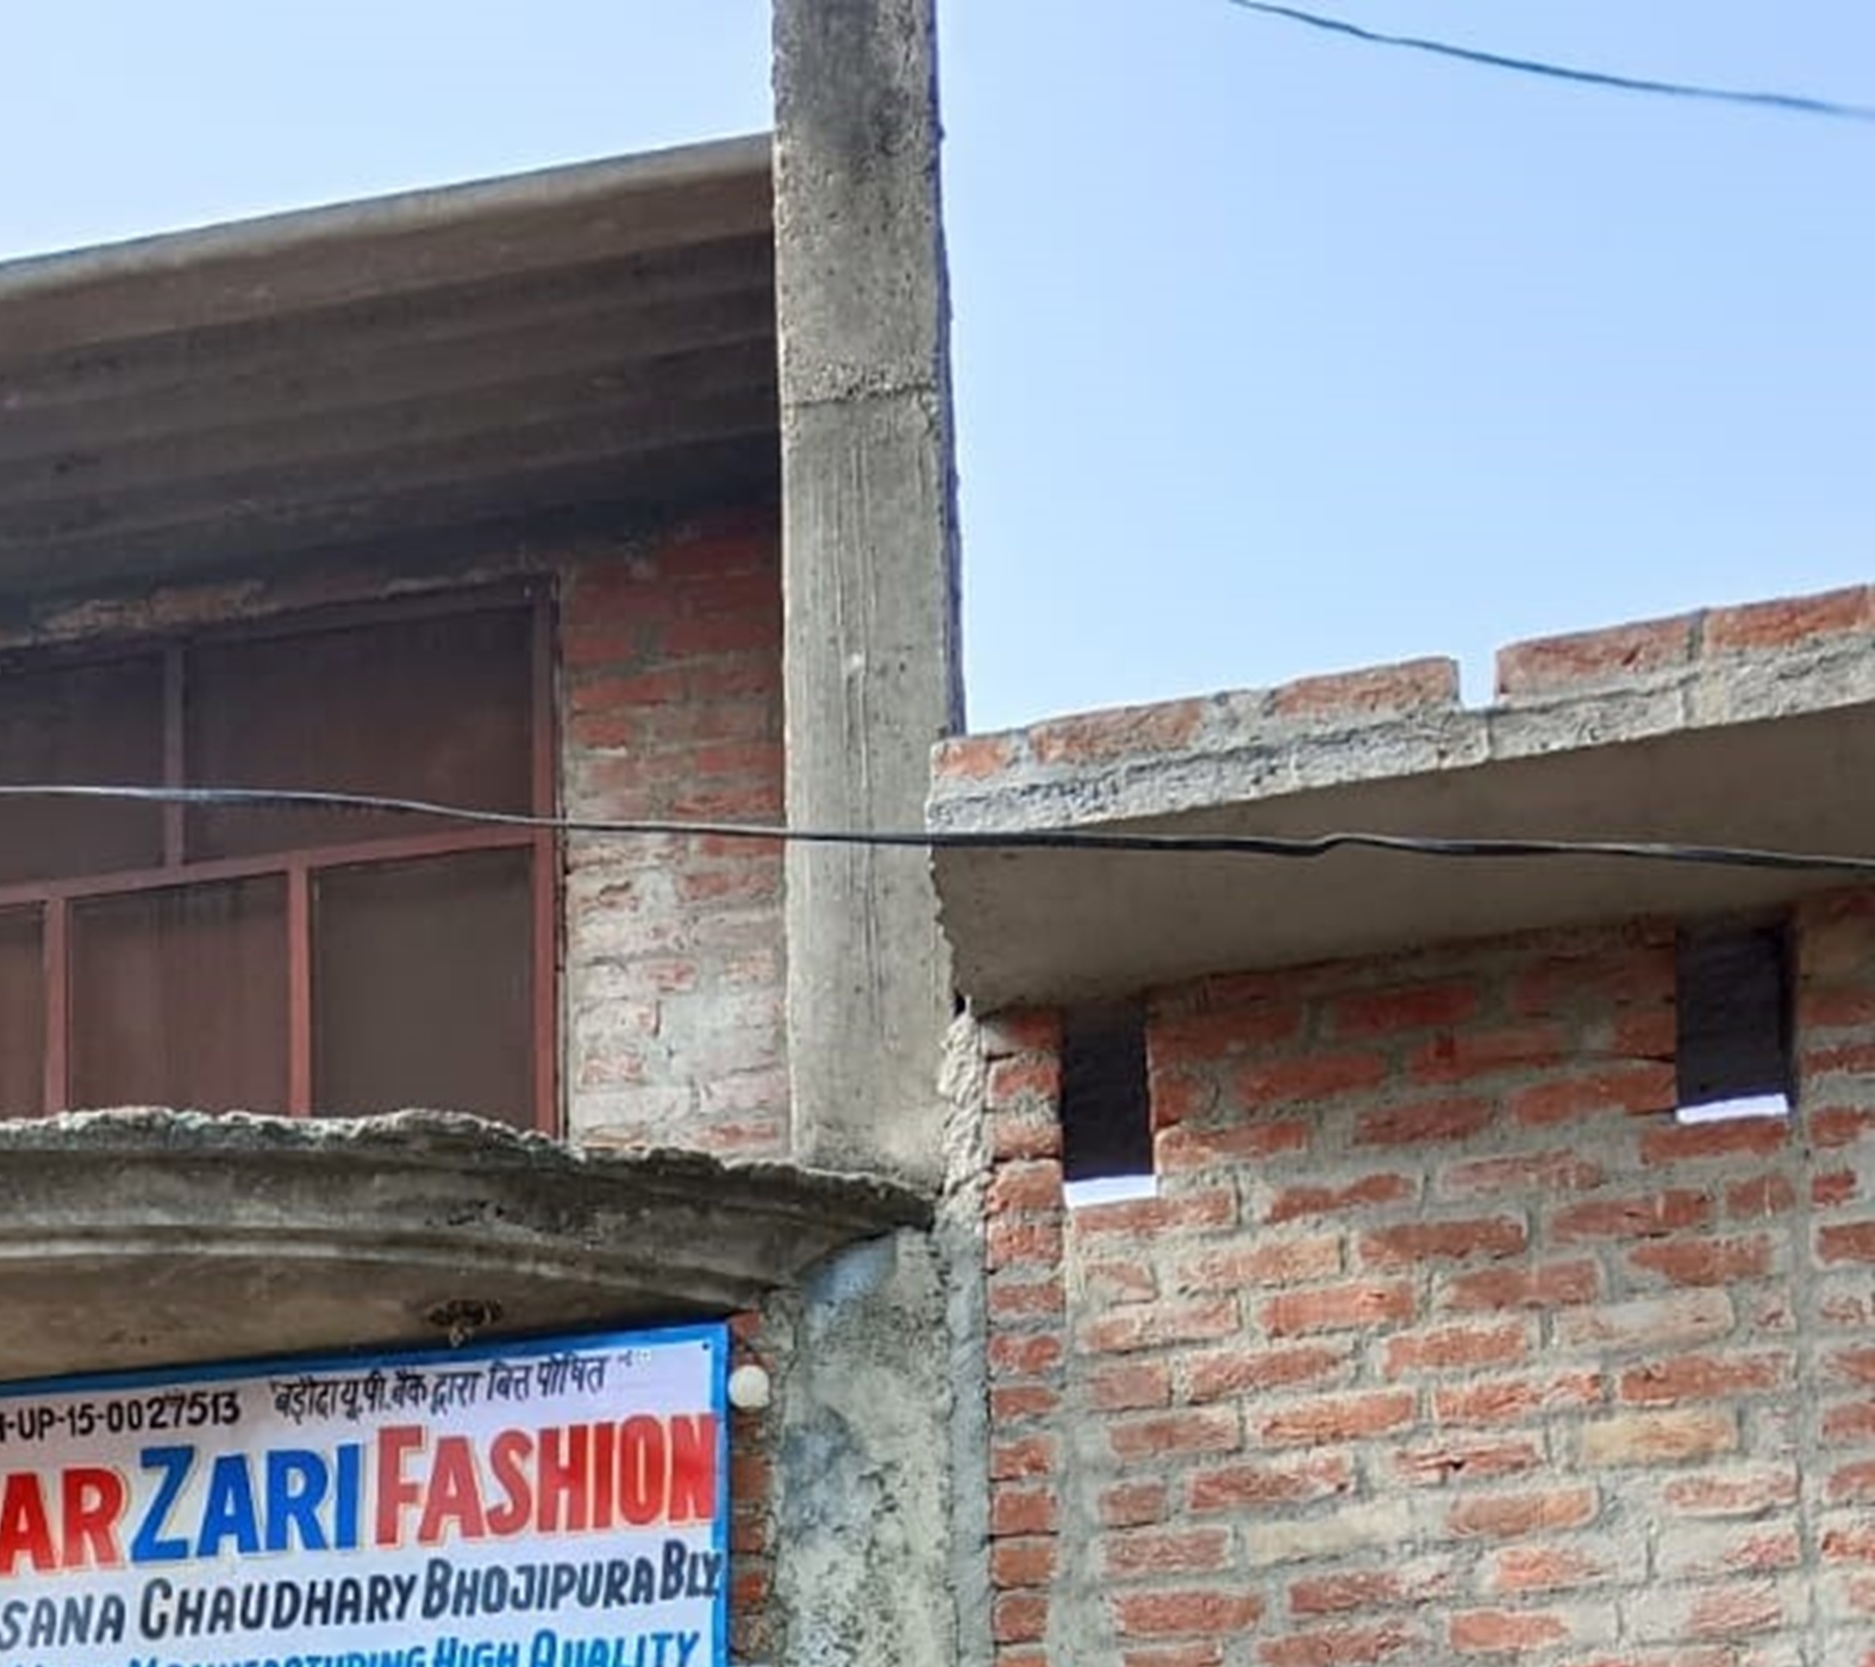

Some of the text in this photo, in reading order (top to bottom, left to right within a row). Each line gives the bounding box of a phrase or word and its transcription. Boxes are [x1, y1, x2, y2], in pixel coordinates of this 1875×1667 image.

[130, 1444, 362, 1563] ZARI
[375, 1414, 718, 1547] FASHION
[139, 1572, 418, 1641] CHAUDHARY
[422, 1556, 655, 1620] BHOJIPURA
[659, 1539, 723, 1601] BLY
